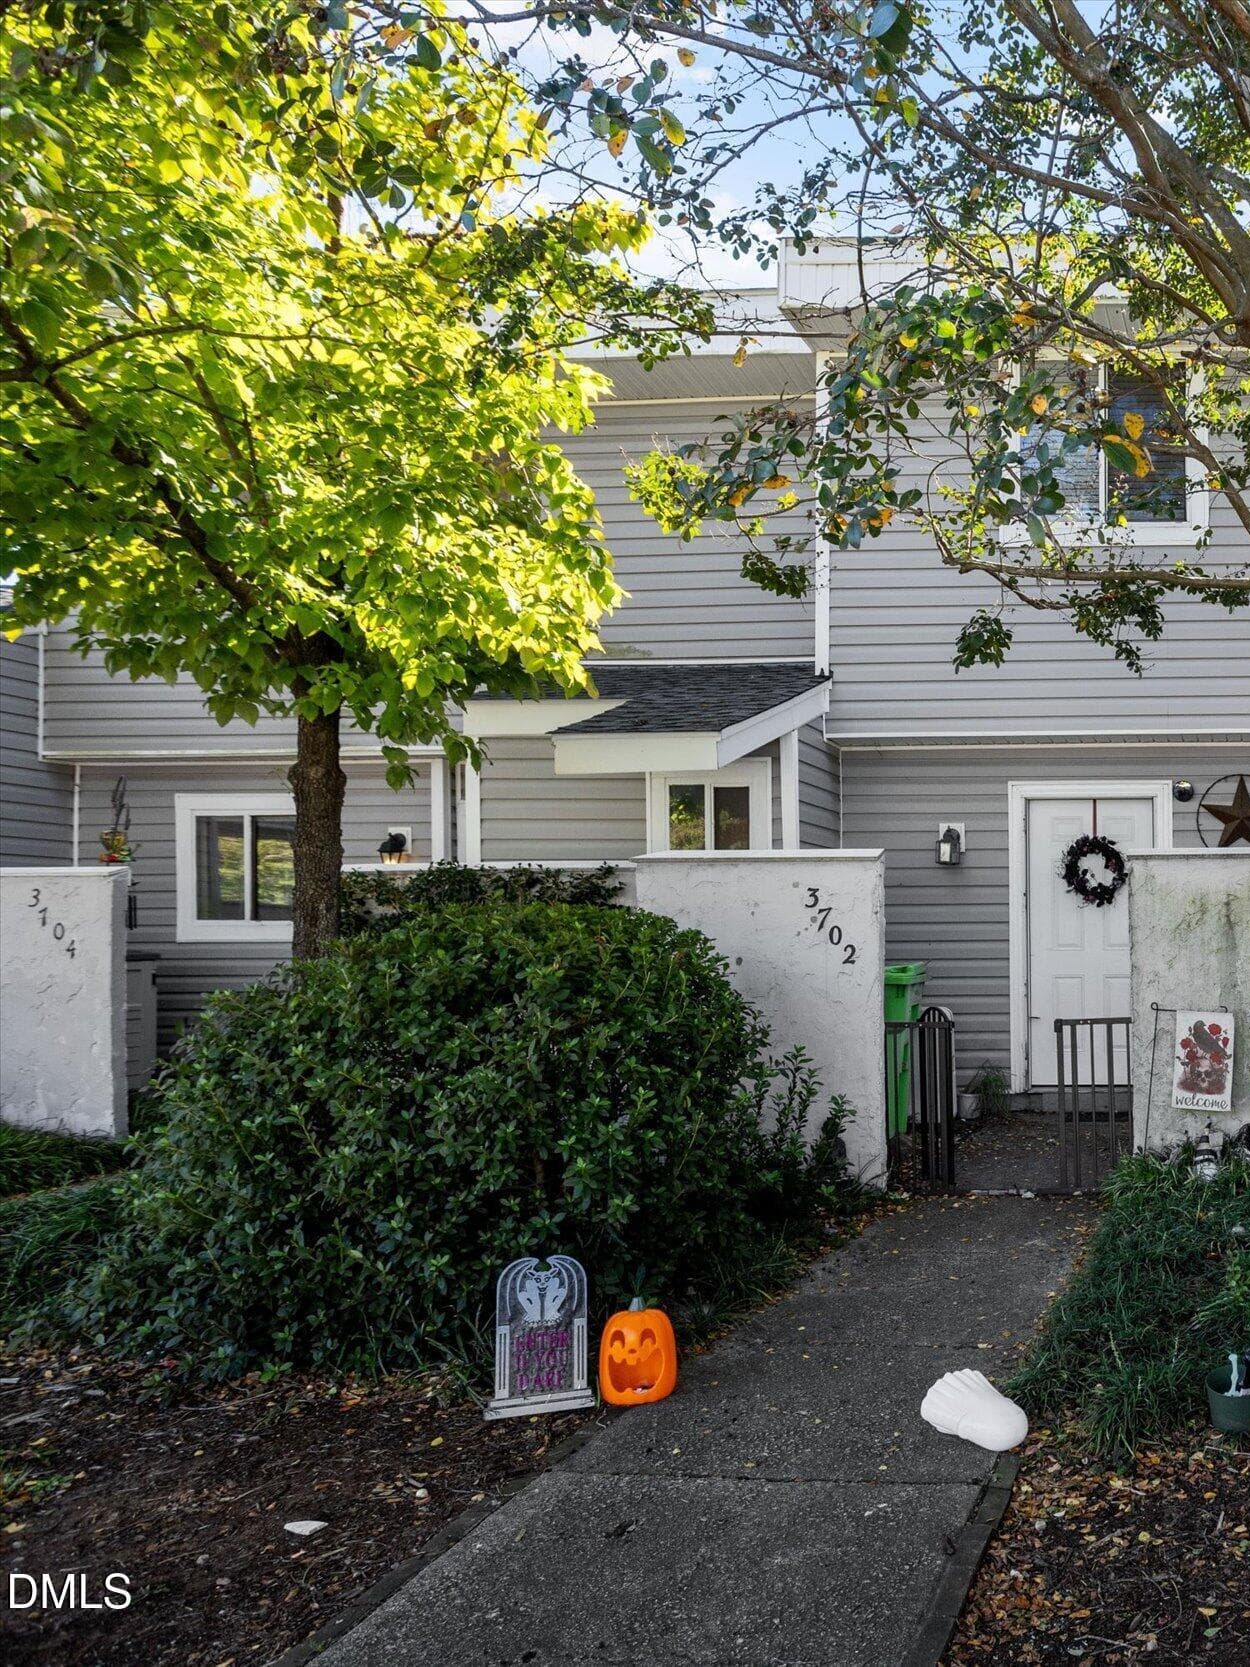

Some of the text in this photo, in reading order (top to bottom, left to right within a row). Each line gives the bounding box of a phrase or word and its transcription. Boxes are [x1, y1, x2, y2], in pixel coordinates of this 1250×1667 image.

[28, 888, 76, 959] 3704
[805, 887, 856, 965] 3702
[1175, 1092, 1228, 1110] welcome
[514, 1329, 570, 1350] ENTER
[534, 1349, 568, 1368] YOU
[516, 1370, 566, 1390] DARE
